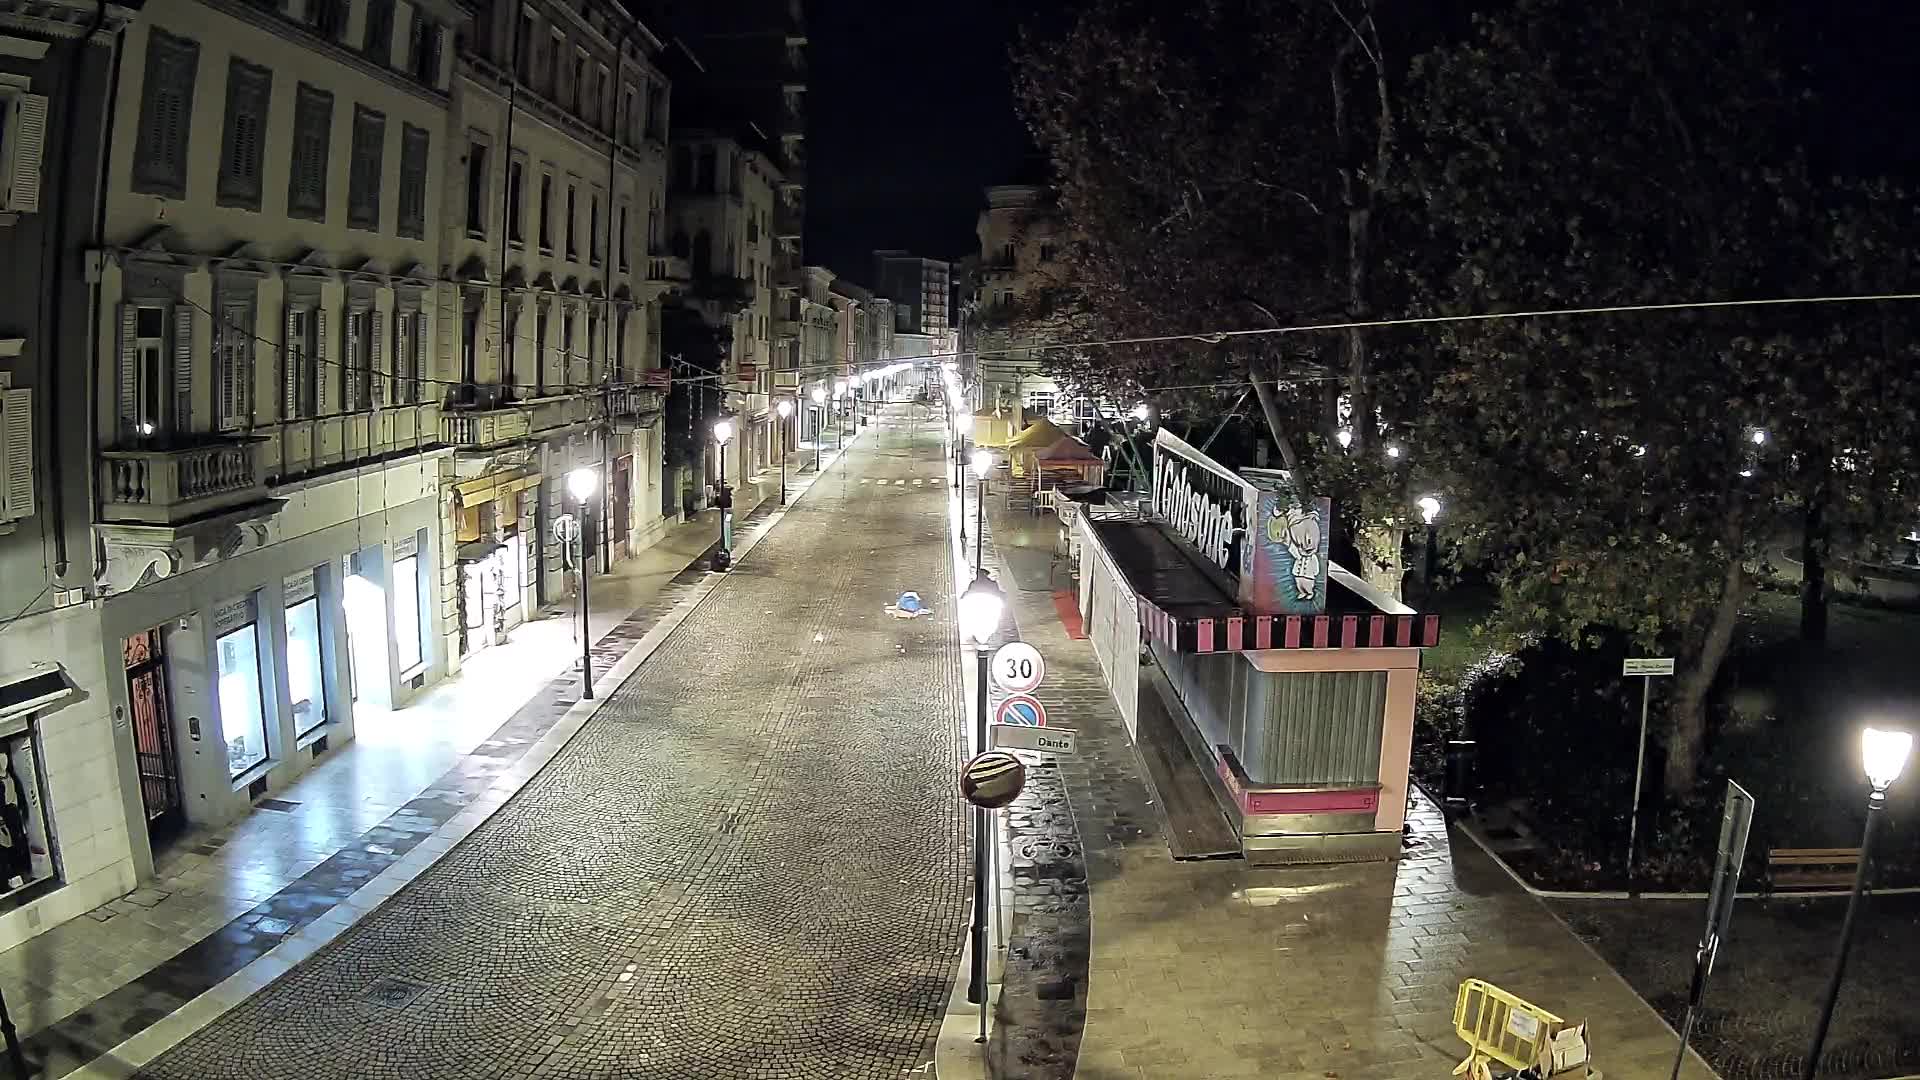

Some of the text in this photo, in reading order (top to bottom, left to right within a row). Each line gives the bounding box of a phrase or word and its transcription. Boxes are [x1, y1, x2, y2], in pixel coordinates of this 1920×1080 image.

[1162, 458, 1233, 569] Golosone
[1006, 658, 1032, 679] 30
[1038, 737, 1069, 749] Dante
